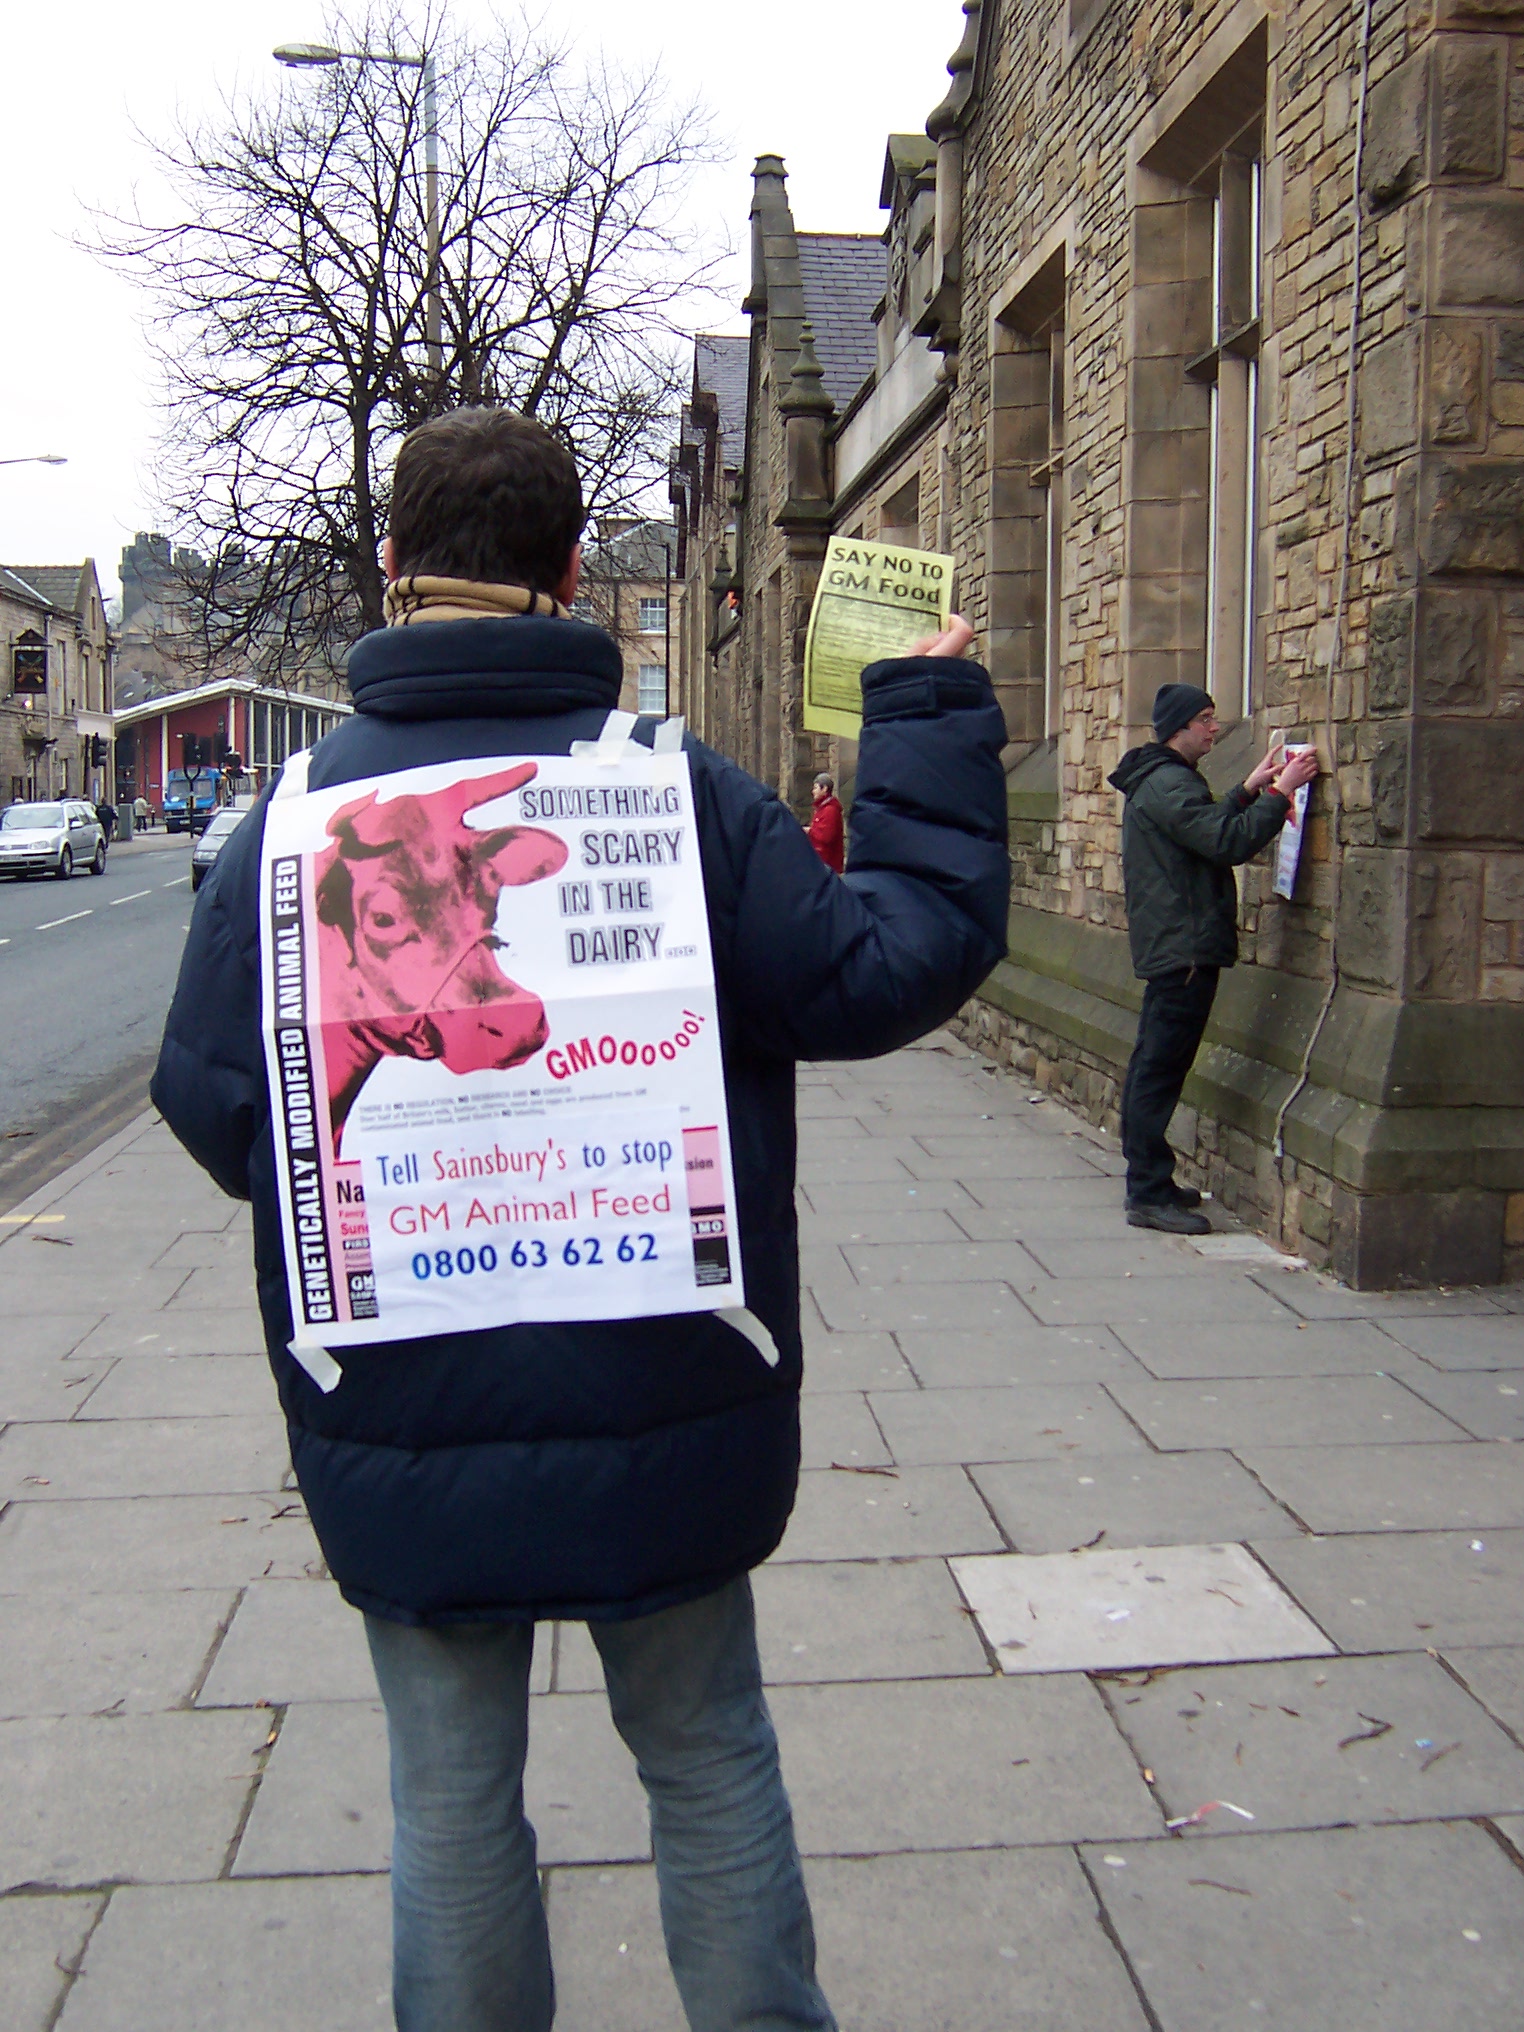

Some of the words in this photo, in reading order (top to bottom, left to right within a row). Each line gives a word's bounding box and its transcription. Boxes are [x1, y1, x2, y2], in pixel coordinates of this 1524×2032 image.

[829, 569, 870, 591] GM
[879, 577, 941, 604] Food
[832, 547, 876, 567] SAY
[883, 555, 913, 573] NO
[919, 561, 943, 580] TO
[520, 787, 681, 821] SOMETHING
[580, 828, 684, 868] SCARY
[276, 859, 299, 916] FEED
[558, 881, 594, 917] IN
[598, 877, 653, 913] THE
[277, 922, 302, 1021] ANIMAL
[280, 1028, 315, 1150] MODIFIED
[376, 1153, 419, 1186] Tell
[433, 1139, 567, 1182] Sainsbury's
[582, 1143, 606, 1168] to
[622, 1139, 672, 1172] stop
[390, 1201, 450, 1235] GM
[465, 1191, 577, 1229] Animal
[592, 1184, 671, 1218] Feed
[293, 1157, 333, 1322] GENETICALLY
[412, 1244, 497, 1280] 0800
[511, 1240, 547, 1267] 63
[563, 1238, 603, 1265] 62
[617, 1233, 658, 1262] 62
